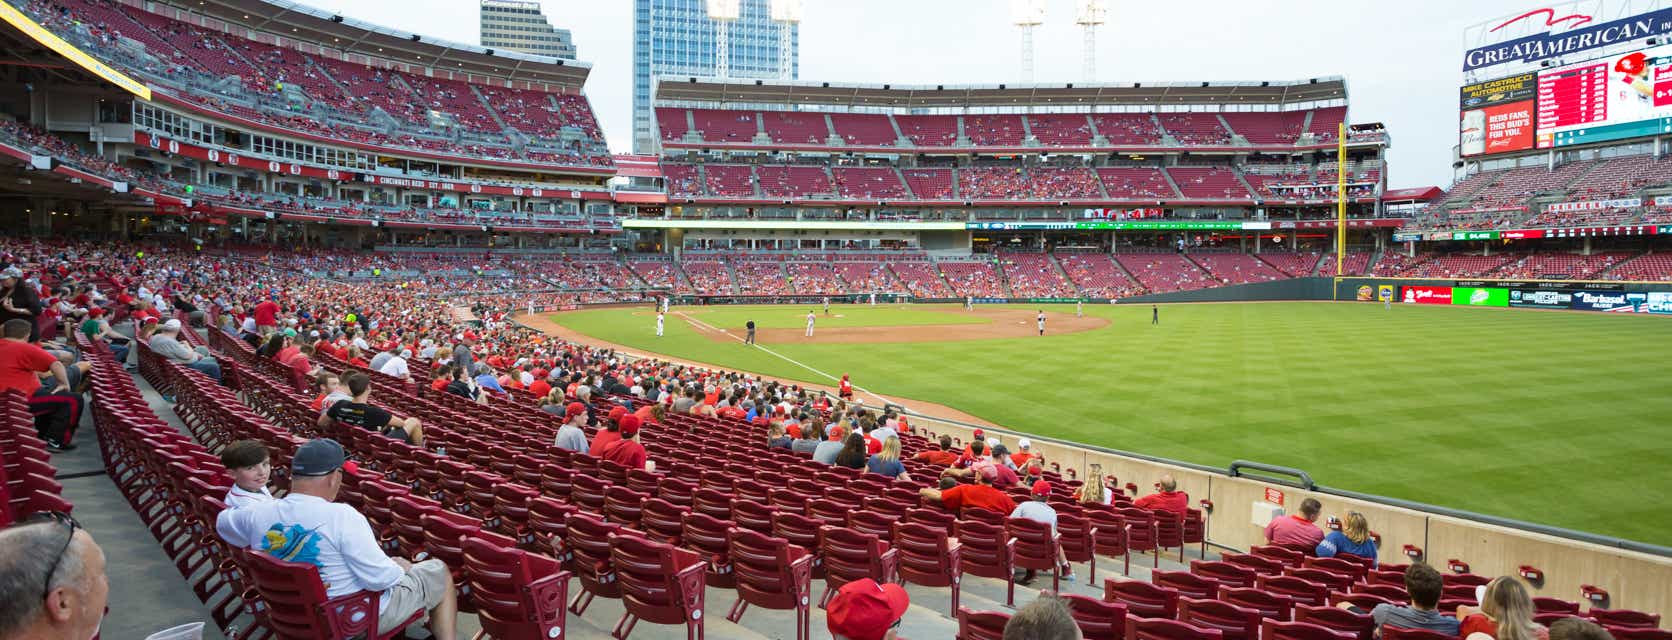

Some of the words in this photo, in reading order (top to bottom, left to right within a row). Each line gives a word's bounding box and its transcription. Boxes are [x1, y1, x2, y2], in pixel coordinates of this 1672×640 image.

[1462, 84, 1483, 93] MIKE
[1484, 74, 1534, 88] CASTRUCCI
[1471, 83, 1524, 98] AUTOMOTIVE
[1489, 121, 1506, 131] THIS
[1489, 131, 1504, 139] FOR
